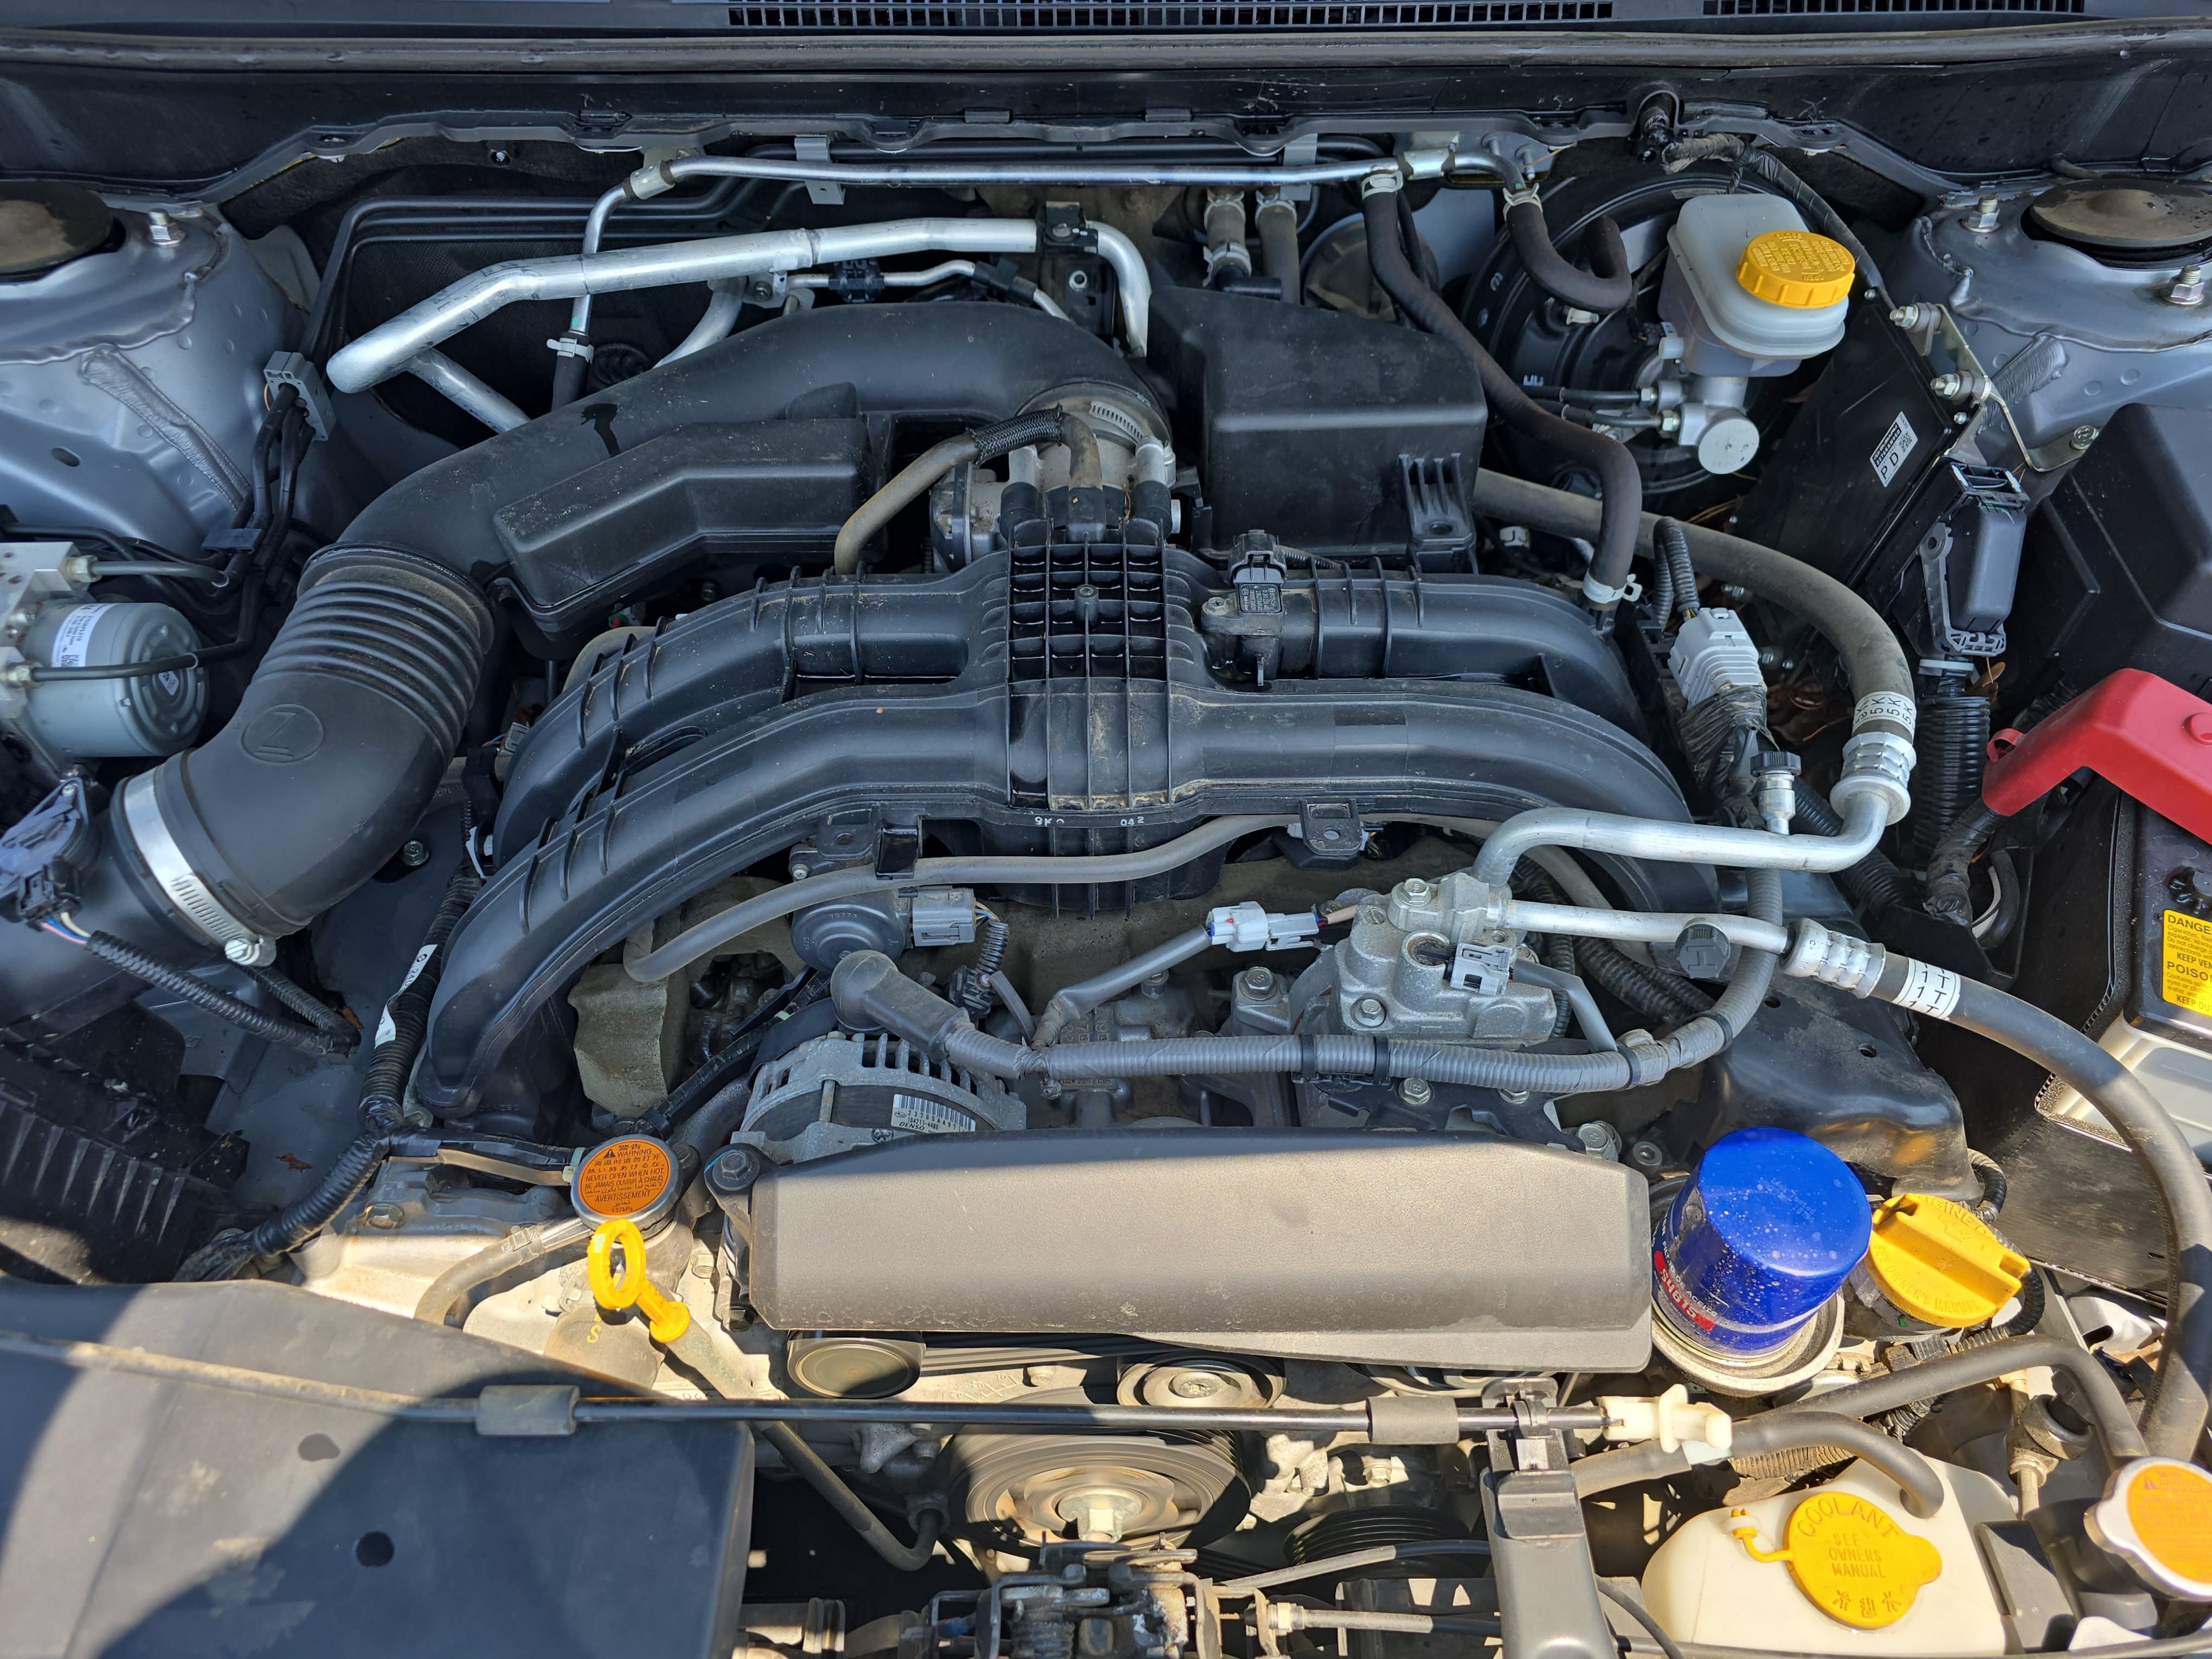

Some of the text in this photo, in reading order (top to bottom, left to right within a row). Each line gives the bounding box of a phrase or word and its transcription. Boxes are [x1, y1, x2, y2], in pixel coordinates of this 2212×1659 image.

[2168, 914, 2212, 935] DANGE
[2177, 952, 2196, 964] KEEP
[2167, 961, 2212, 982] POISO
[2176, 994, 2196, 1006] KEEP
[899, 1121, 925, 1131] DENSO
[617, 1148, 652, 1157] WARNING
[586, 1174, 607, 1182] NEVER
[609, 1172, 627, 1180] OPEN
[629, 1169, 648, 1178] WHEN
[594, 1180, 614, 1188] JAMAIS
[595, 1190, 651, 1203] AVERTISSEMENT
[1676, 1275, 1686, 1289] DE
[1661, 1268, 1697, 1318] S4615
[1798, 1496, 1900, 1538] COOLANT
[1833, 1533, 1861, 1546] SEE
[1829, 1546, 1882, 1562] OWNERS
[1831, 1562, 1887, 1579] MANUAL
